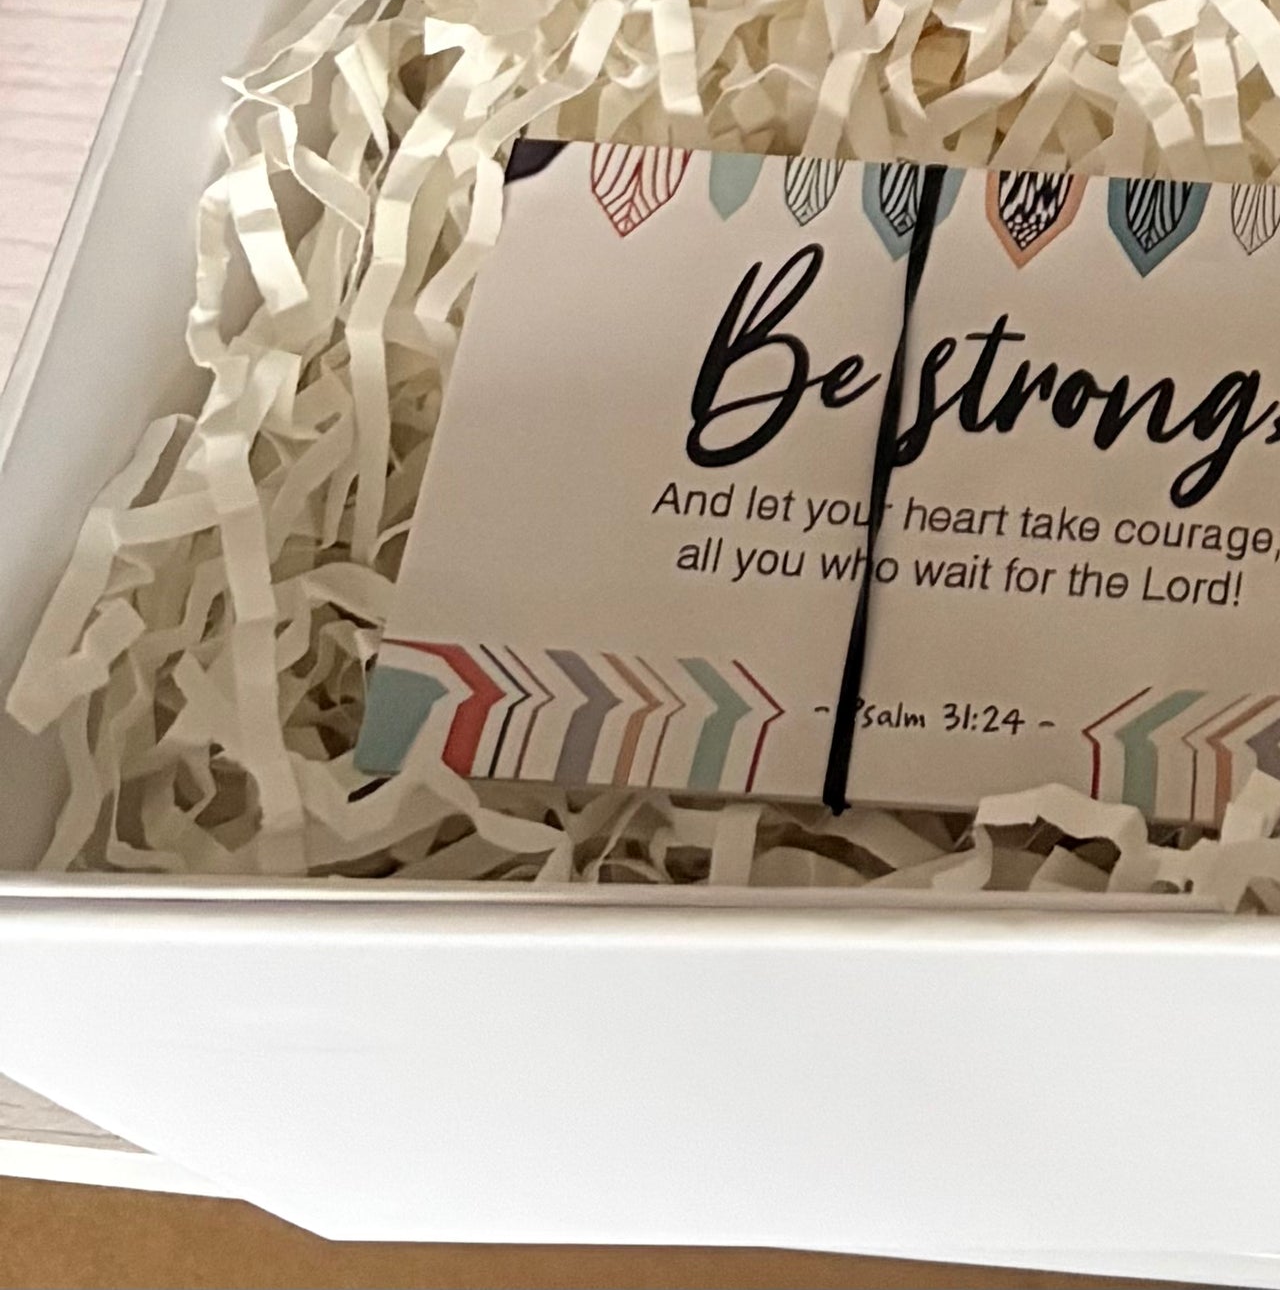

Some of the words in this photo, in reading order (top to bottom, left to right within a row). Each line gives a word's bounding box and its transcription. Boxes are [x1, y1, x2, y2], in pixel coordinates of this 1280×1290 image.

[686, 243, 882, 467] Be
[652, 482, 735, 517] And
[746, 485, 796, 521] let
[803, 497, 893, 533] you
[903, 496, 1009, 537] heart
[1020, 506, 1099, 542] take
[1114, 518, 1280, 563] courage,
[676, 537, 723, 573] all
[731, 547, 805, 583] you
[914, 553, 993, 591] wait
[1004, 556, 1057, 595] for
[1068, 562, 1129, 599] the
[1142, 565, 1243, 607] Lord!
[943, 702, 1026, 735] 31:24
